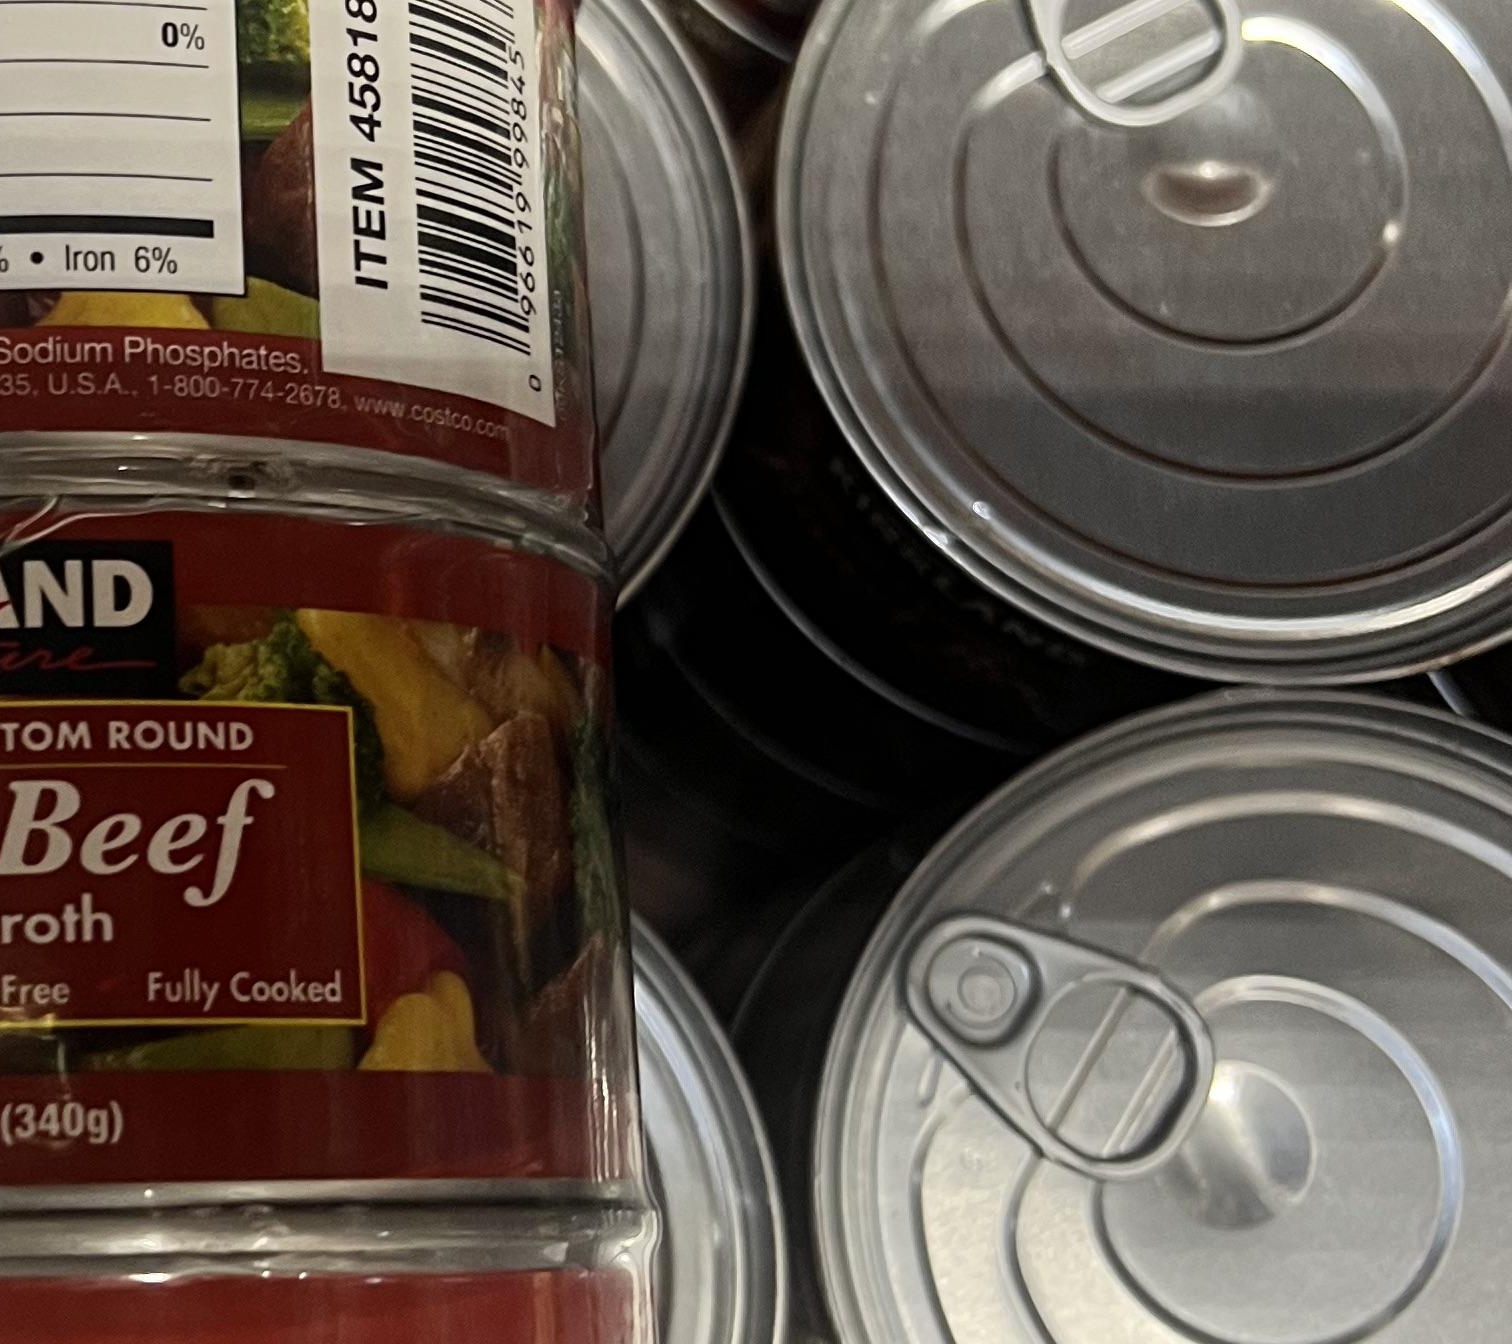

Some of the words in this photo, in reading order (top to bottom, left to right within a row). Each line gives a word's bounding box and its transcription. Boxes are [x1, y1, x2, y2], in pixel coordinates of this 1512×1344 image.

[160, 21, 207, 52] 0%
[508, 48, 530, 169] 99845
[351, 157, 391, 293] ITEM
[63, 244, 116, 274] Iron
[133, 245, 179, 276] 6%
[514, 190, 539, 317] 96619
[123, 335, 310, 376] Phosphates.
[527, 373, 543, 394] 0
[352, 392, 511, 442] www.costco.com
[107, 721, 255, 752] ROUND
[0, 974, 71, 1006] Free
[146, 968, 220, 1014] Fully
[229, 968, 344, 1005] Cooked
[0, 1099, 124, 1147] (340g)
